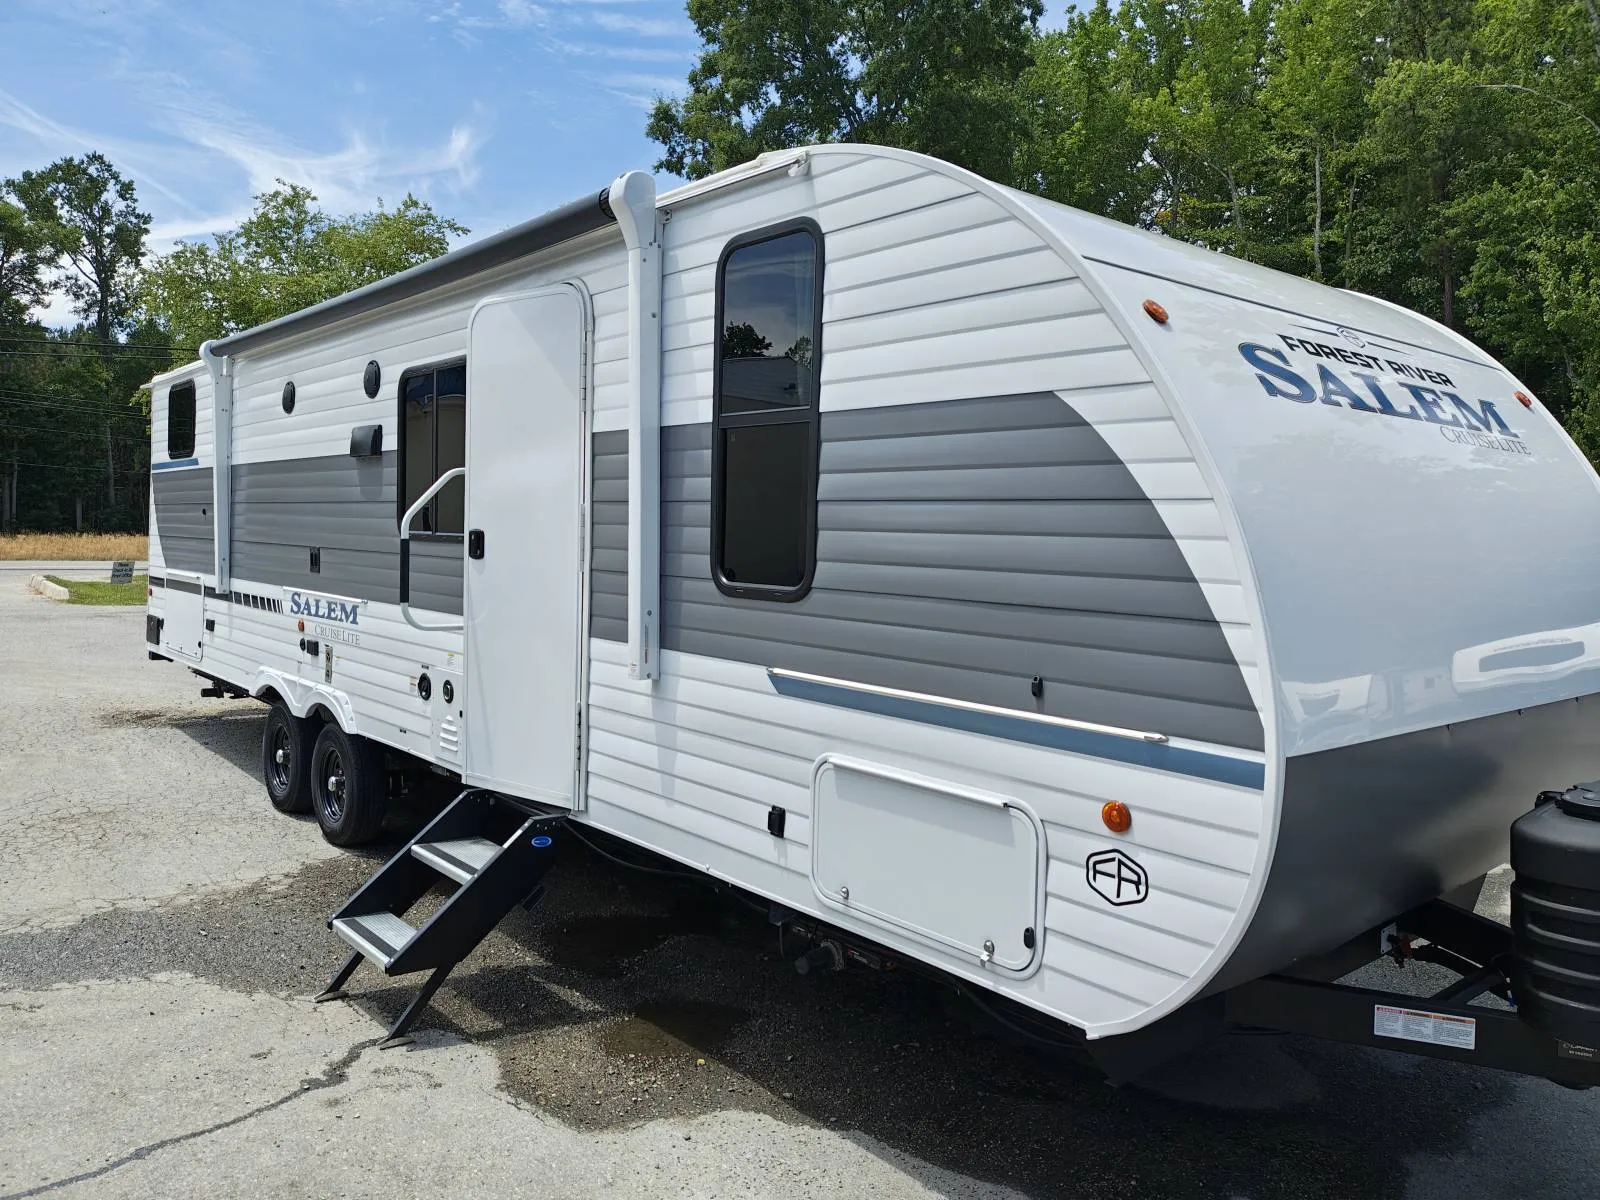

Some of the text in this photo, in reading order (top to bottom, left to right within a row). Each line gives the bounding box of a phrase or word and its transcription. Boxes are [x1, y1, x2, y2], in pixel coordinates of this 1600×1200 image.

[1277, 333, 1384, 371] FOREST
[1385, 359, 1457, 389] RIVER
[1238, 341, 1520, 438] SALEM
[290, 591, 360, 625] SALEM
